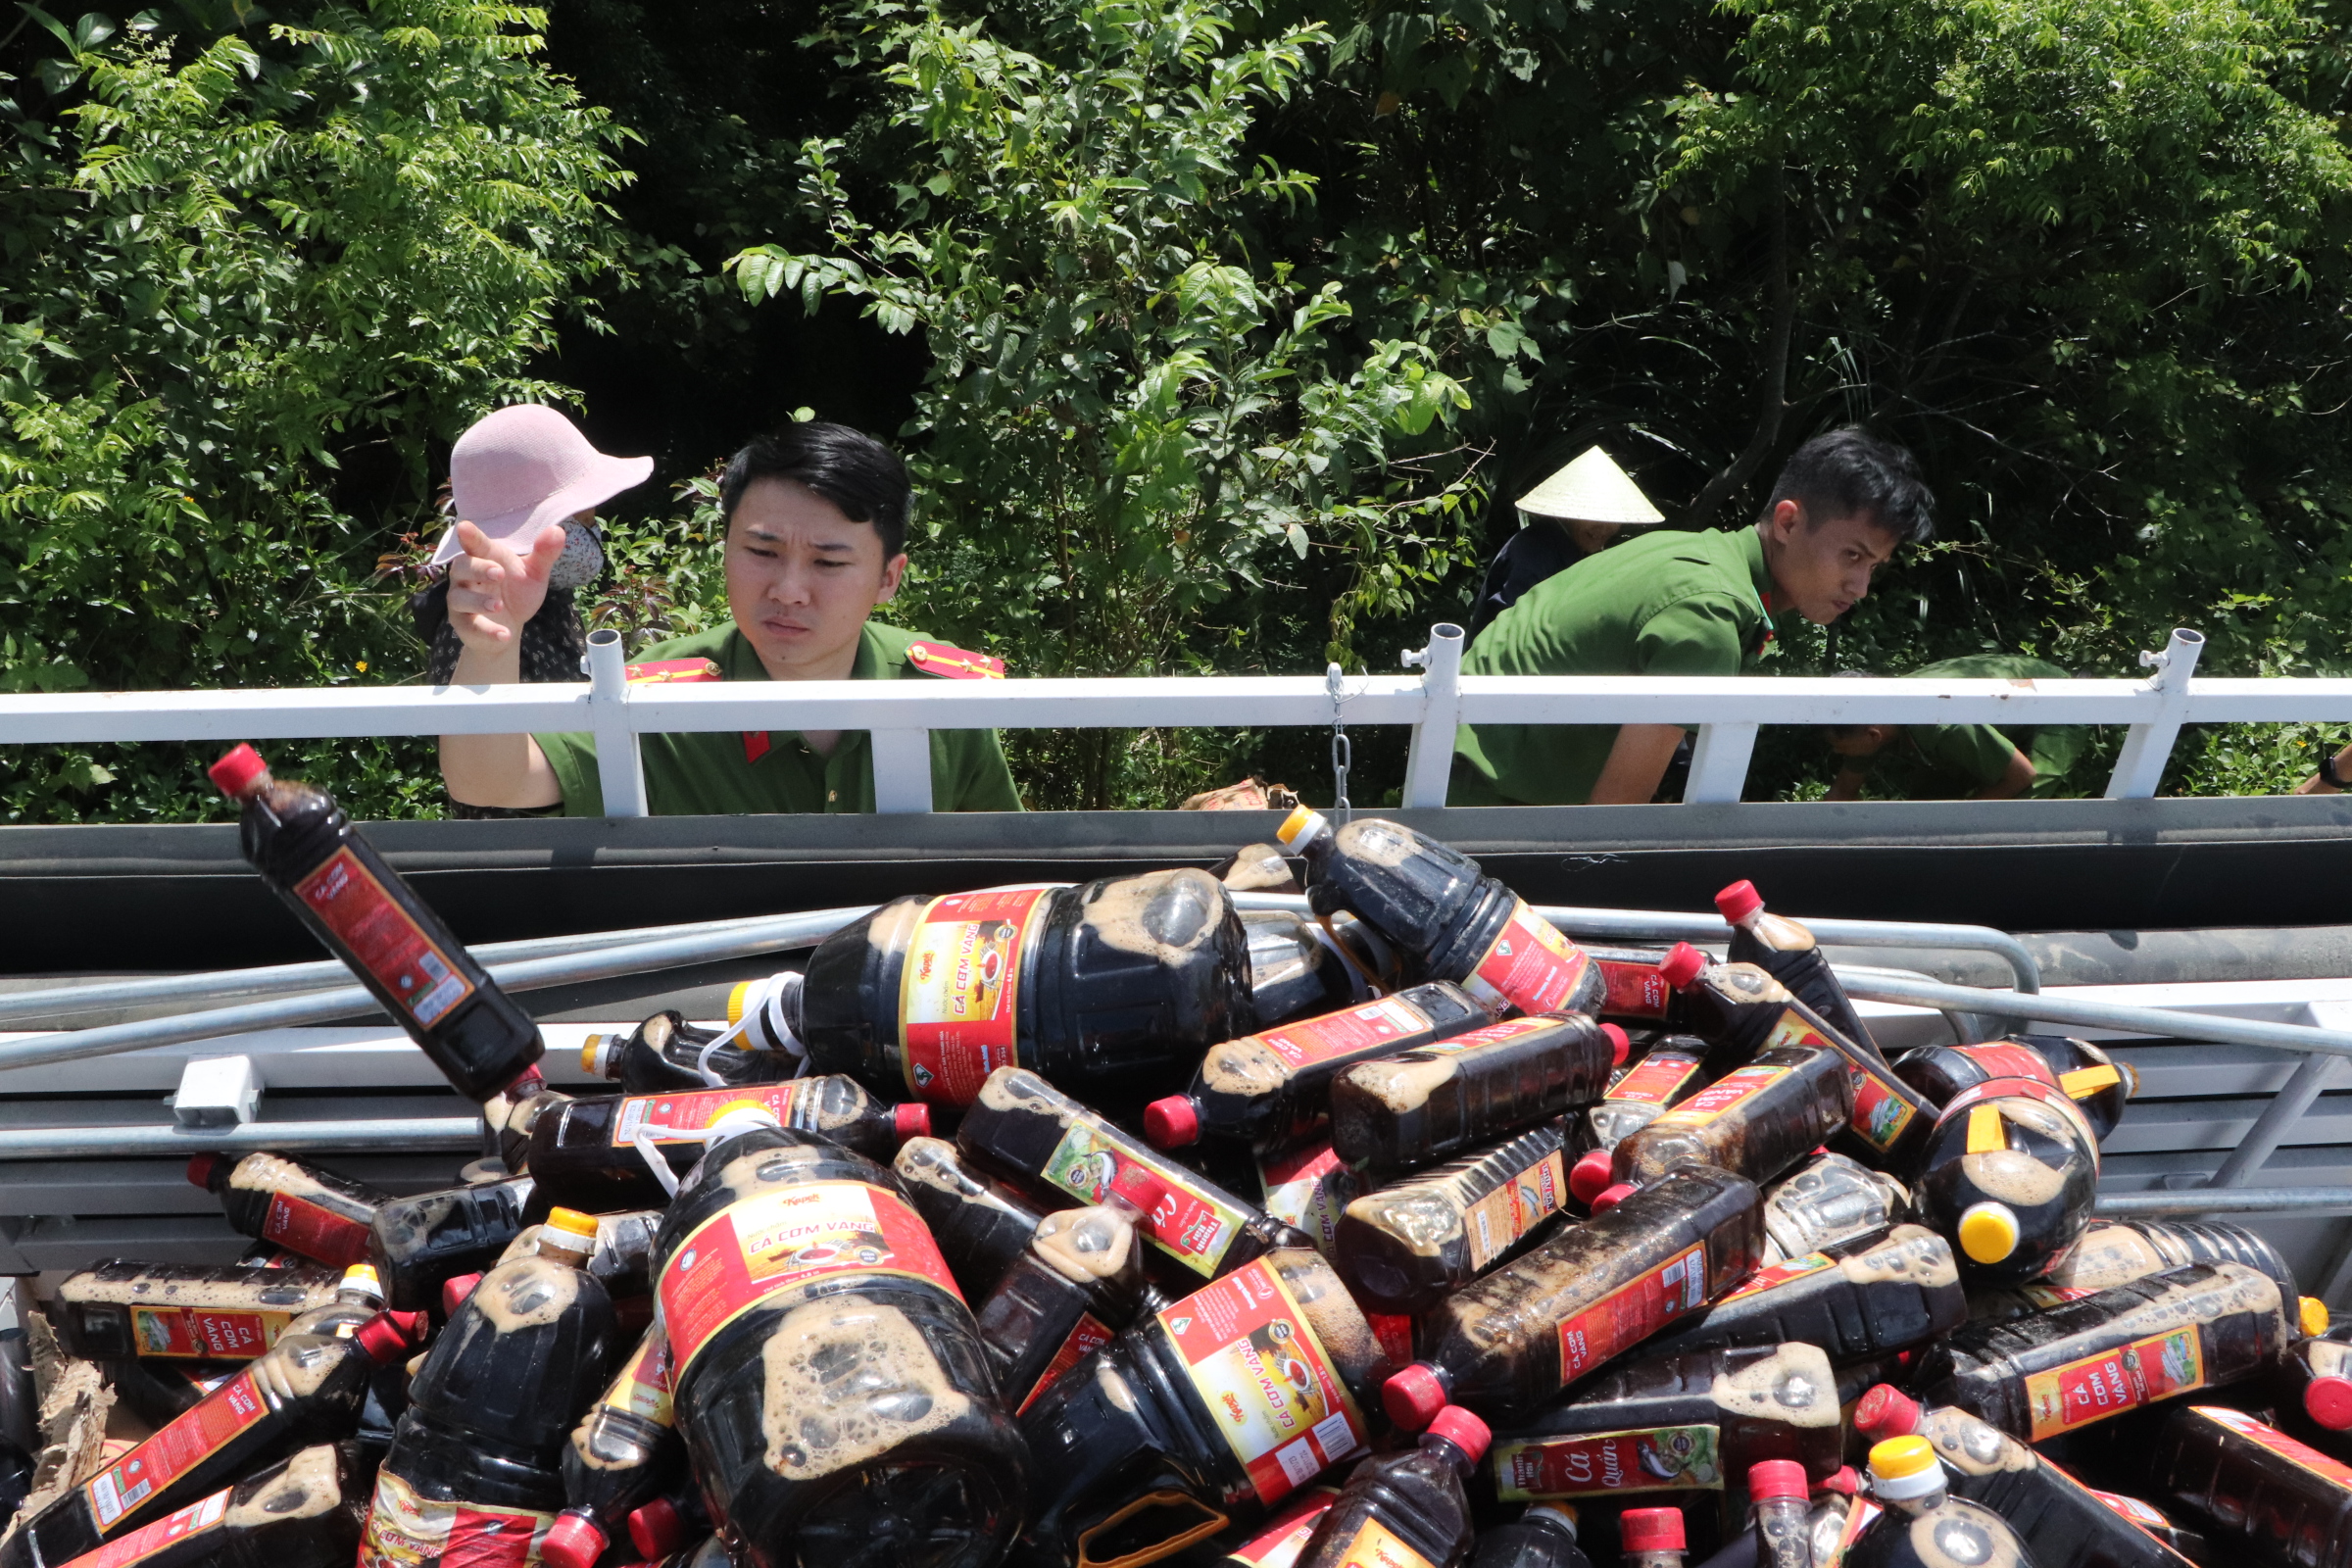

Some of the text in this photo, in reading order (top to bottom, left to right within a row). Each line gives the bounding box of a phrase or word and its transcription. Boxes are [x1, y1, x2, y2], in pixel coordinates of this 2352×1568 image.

[952, 922, 979, 1013] CÁ CƠM VÀNG
[782, 1193, 820, 1206] Kapok
[748, 1221, 874, 1253] CÁ CƠM VÀNG
[1195, 1219, 1218, 1251] Thanh
[1233, 1336, 1265, 1377] VÀNG
[1257, 1374, 1285, 1410] CƠM
[2072, 1383, 2089, 1405] CÁ
[2088, 1371, 2109, 1405] CƠM
[2104, 1360, 2128, 1403] VÀNG
[1219, 1390, 1247, 1424] Kapok
[1274, 1408, 1297, 1432] CÁ
[1563, 1449, 1592, 1483] Cá
